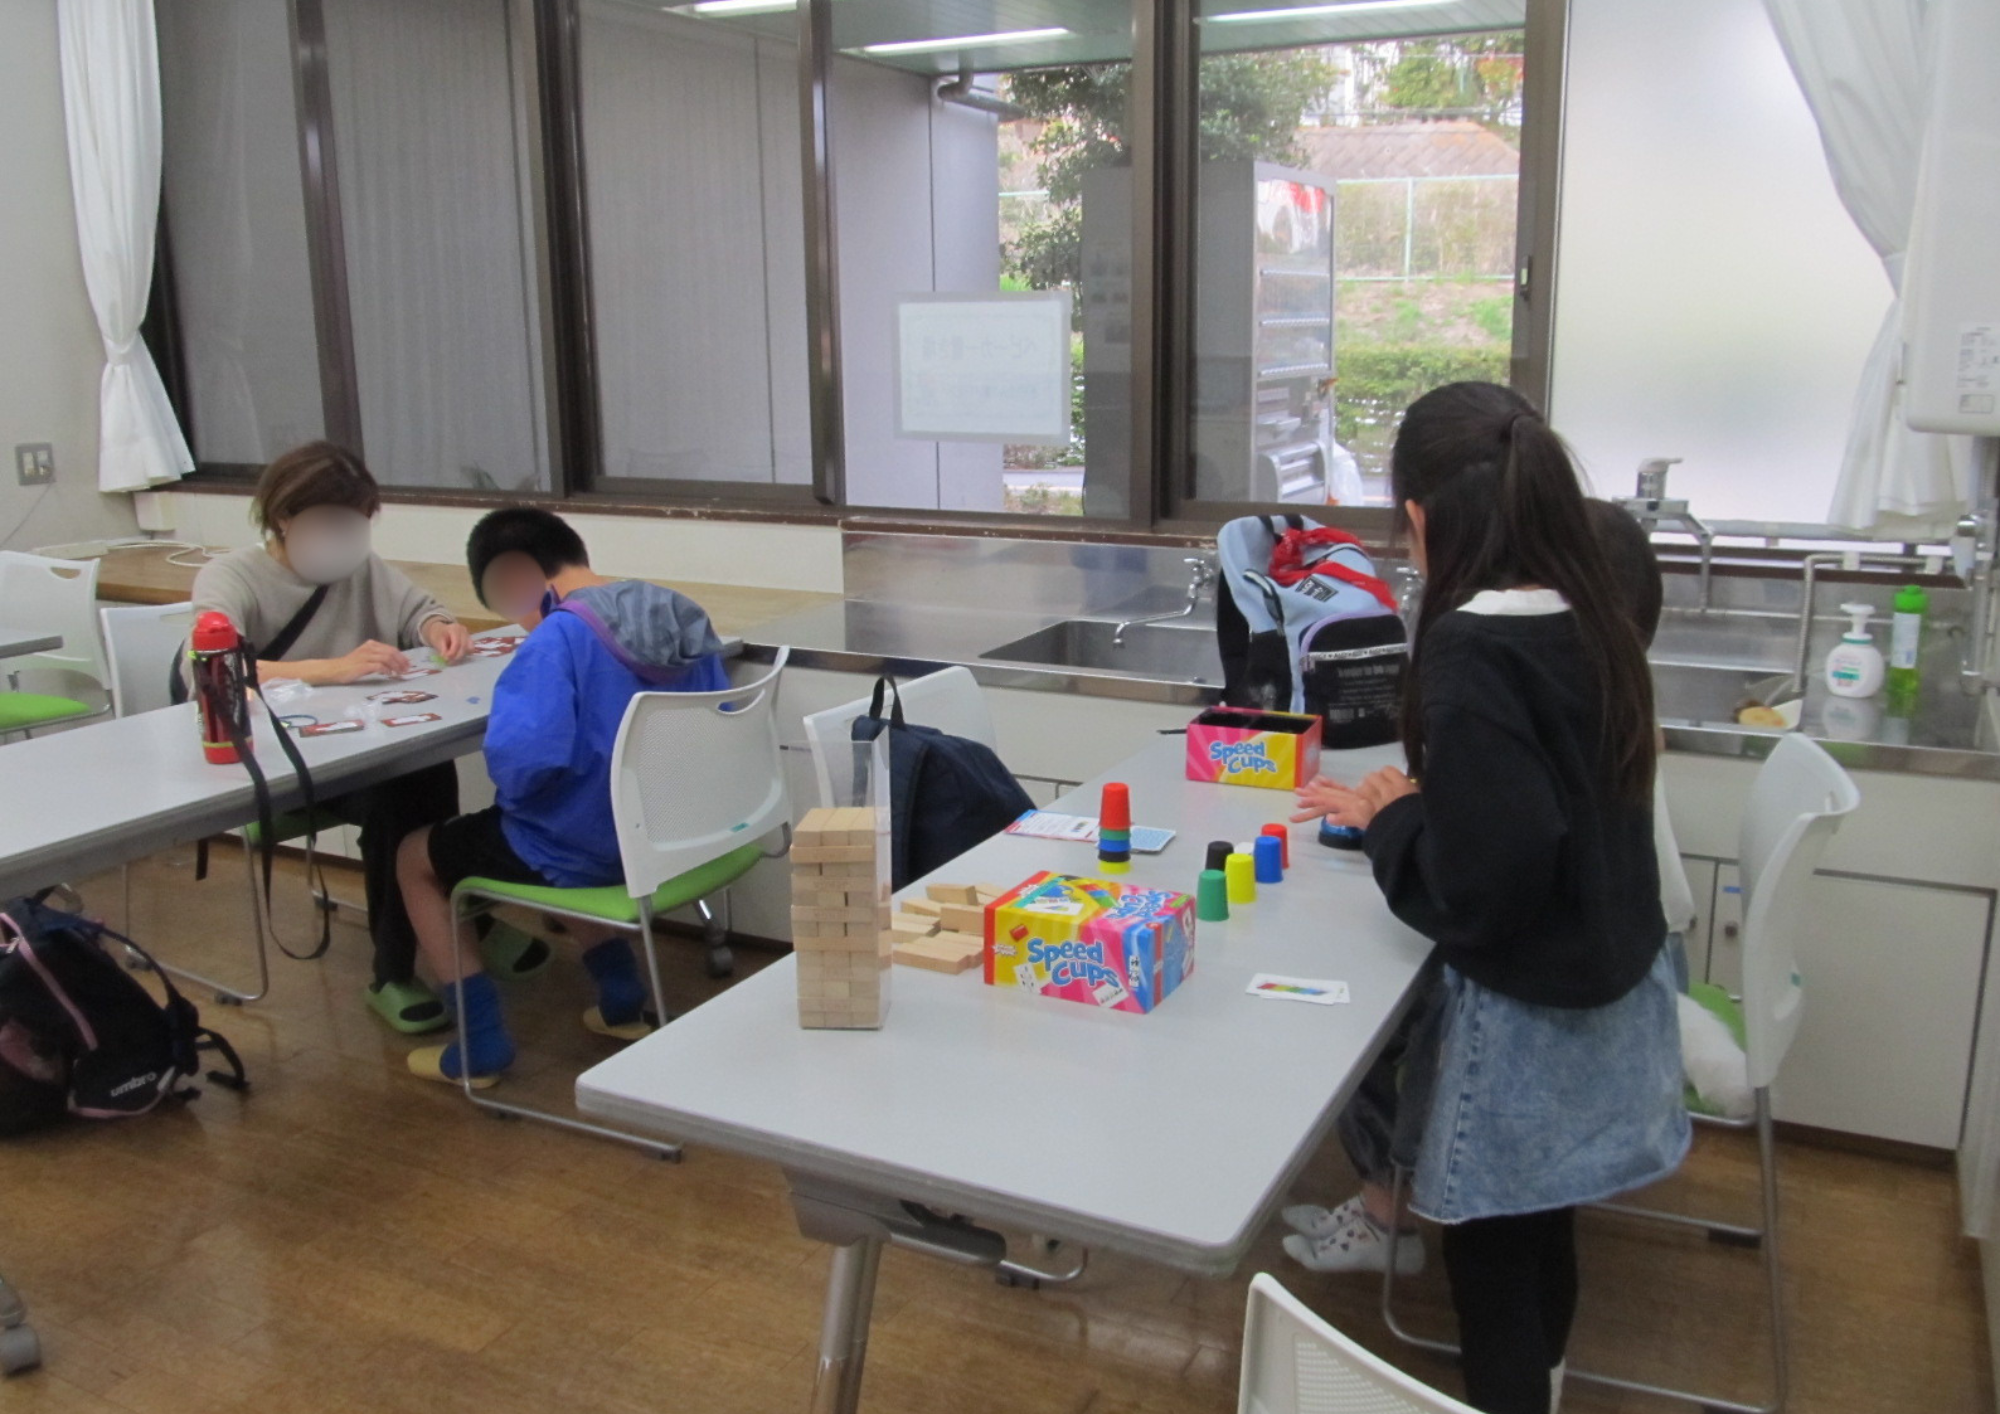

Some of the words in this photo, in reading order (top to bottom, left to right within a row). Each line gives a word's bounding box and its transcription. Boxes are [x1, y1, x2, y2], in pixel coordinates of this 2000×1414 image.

[1210, 740, 1266, 765] Speed
[1227, 756, 1277, 774] Cups
[1027, 937, 1104, 972] Speed
[1051, 960, 1120, 988] Cups
[111, 1071, 157, 1097] umbro
